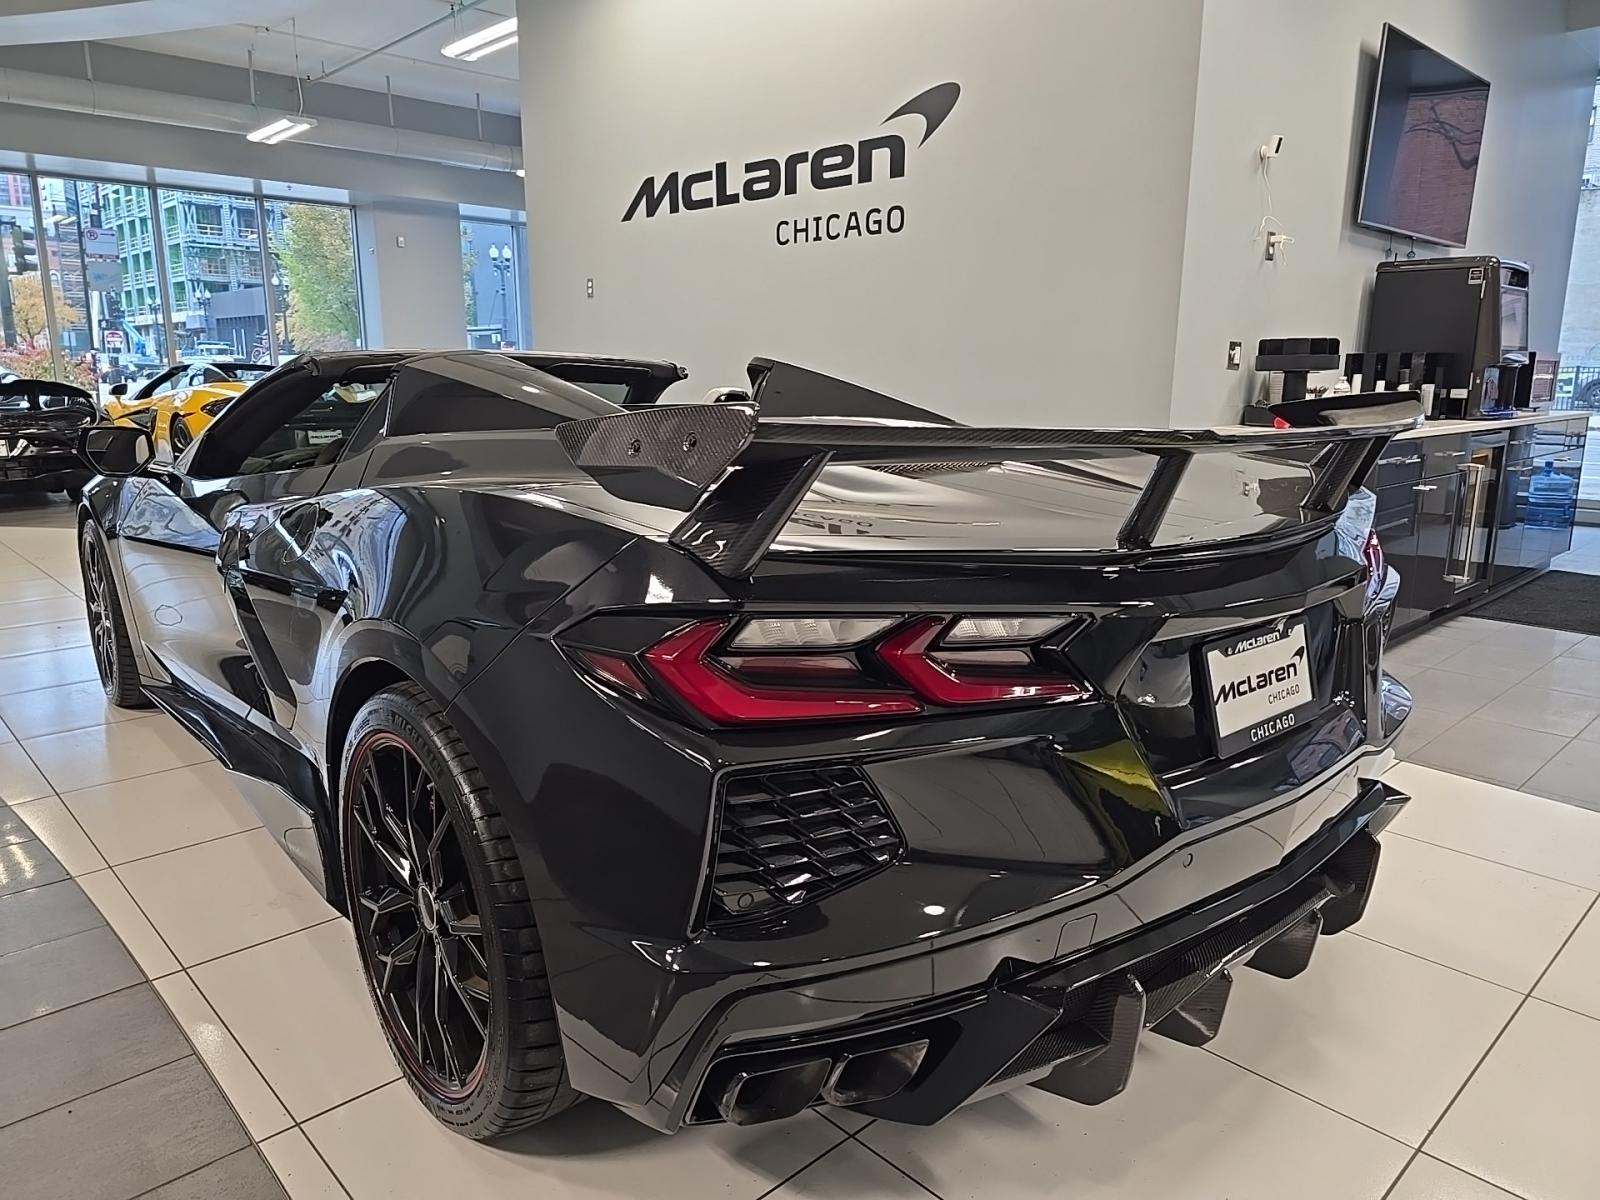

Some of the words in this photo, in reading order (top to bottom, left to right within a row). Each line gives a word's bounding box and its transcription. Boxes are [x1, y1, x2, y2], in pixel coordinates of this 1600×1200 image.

[621, 134, 905, 222] McLaren
[776, 205, 905, 246] CHICAGO
[1234, 631, 1280, 654] McLaren
[1215, 662, 1298, 706] McLaren
[1268, 684, 1300, 705] CHICAGO
[1250, 713, 1295, 742] CHICAGO
